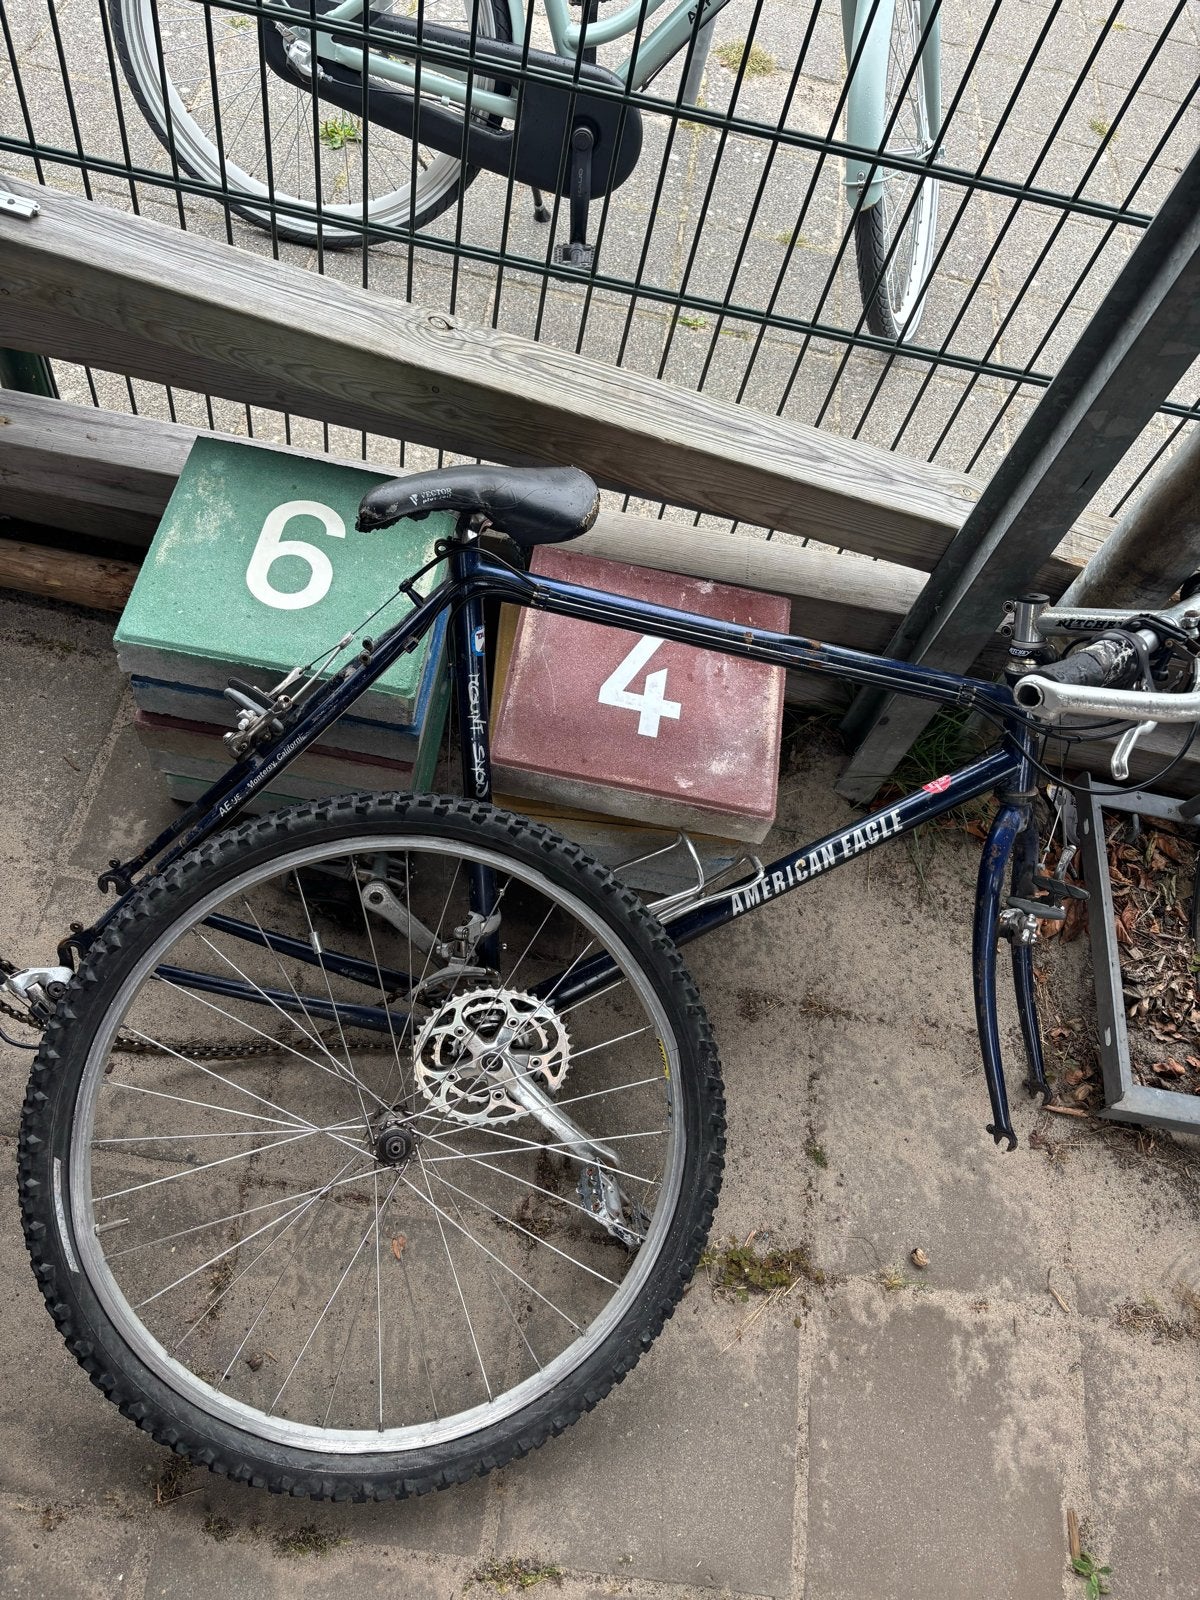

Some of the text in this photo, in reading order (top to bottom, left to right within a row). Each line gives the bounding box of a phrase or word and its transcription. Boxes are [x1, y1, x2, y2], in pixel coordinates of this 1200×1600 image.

[421, 488, 452, 498] VECTOR
[246, 500, 345, 610] 6
[598, 634, 682, 738] 4
[731, 808, 904, 917] AMERICAN EAGLE
